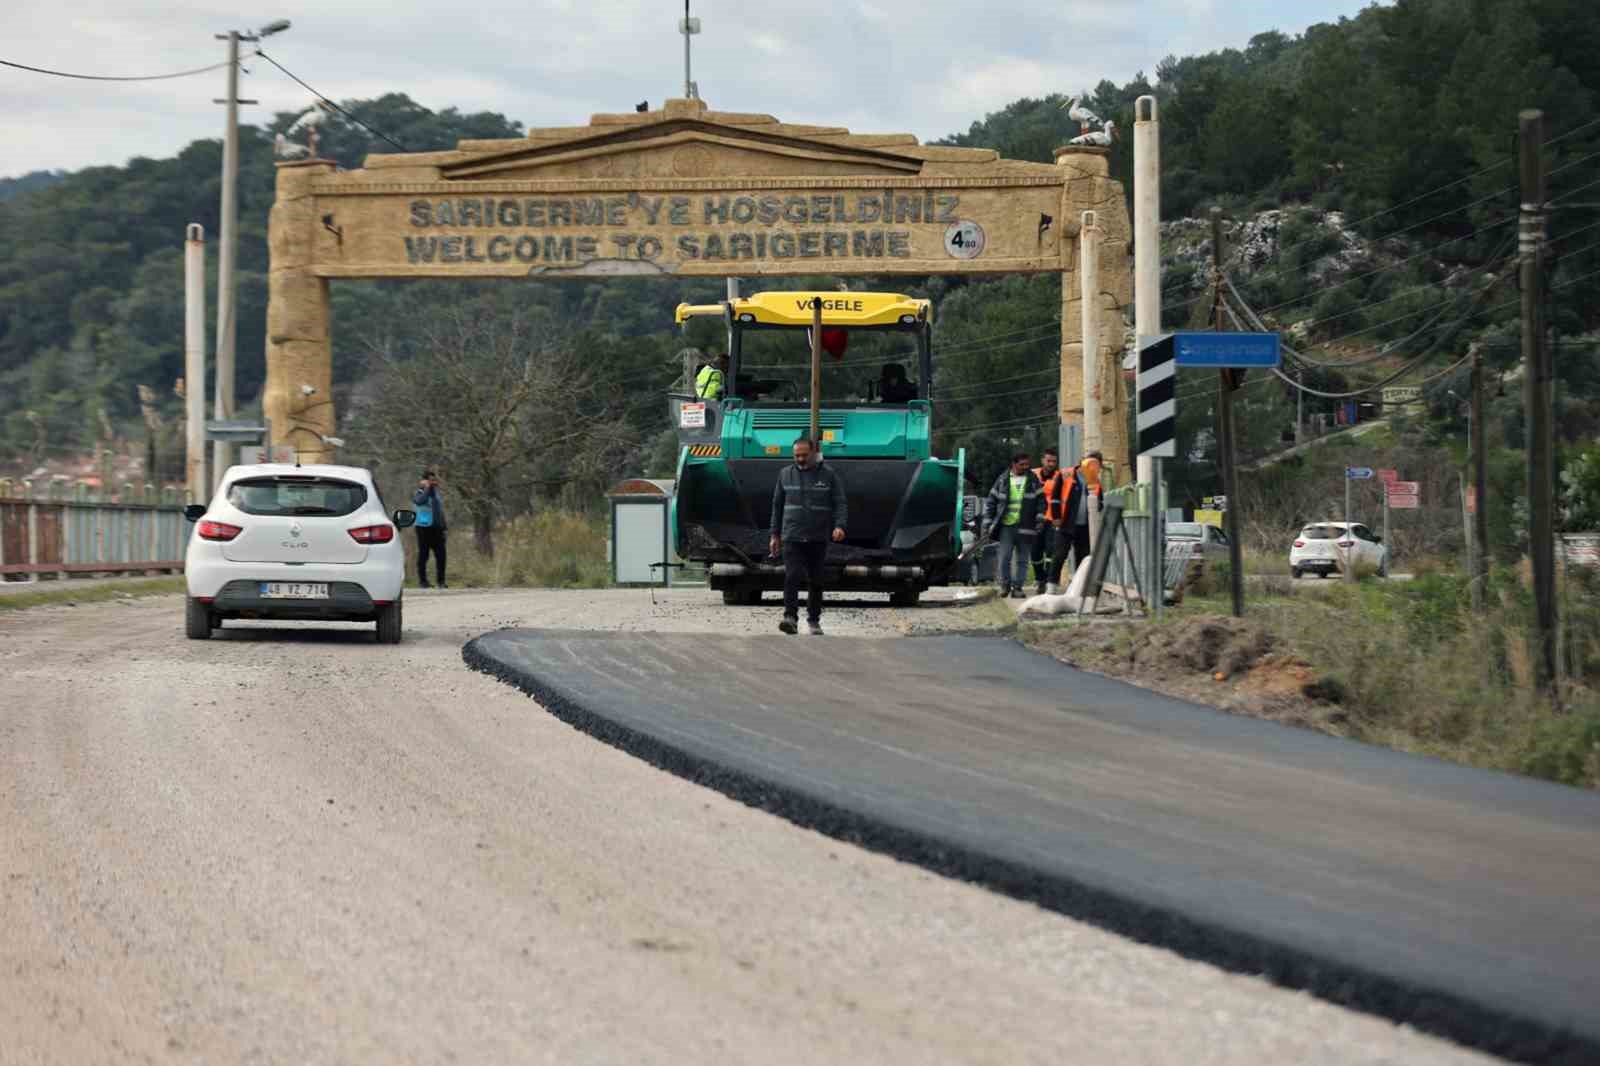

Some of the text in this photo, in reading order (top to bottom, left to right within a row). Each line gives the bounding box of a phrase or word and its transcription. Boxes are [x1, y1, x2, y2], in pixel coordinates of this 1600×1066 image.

[404, 230, 911, 263] WELCOME TO SARIGERME
[951, 230, 963, 249] 4
[281, 541, 309, 549] CLIO
